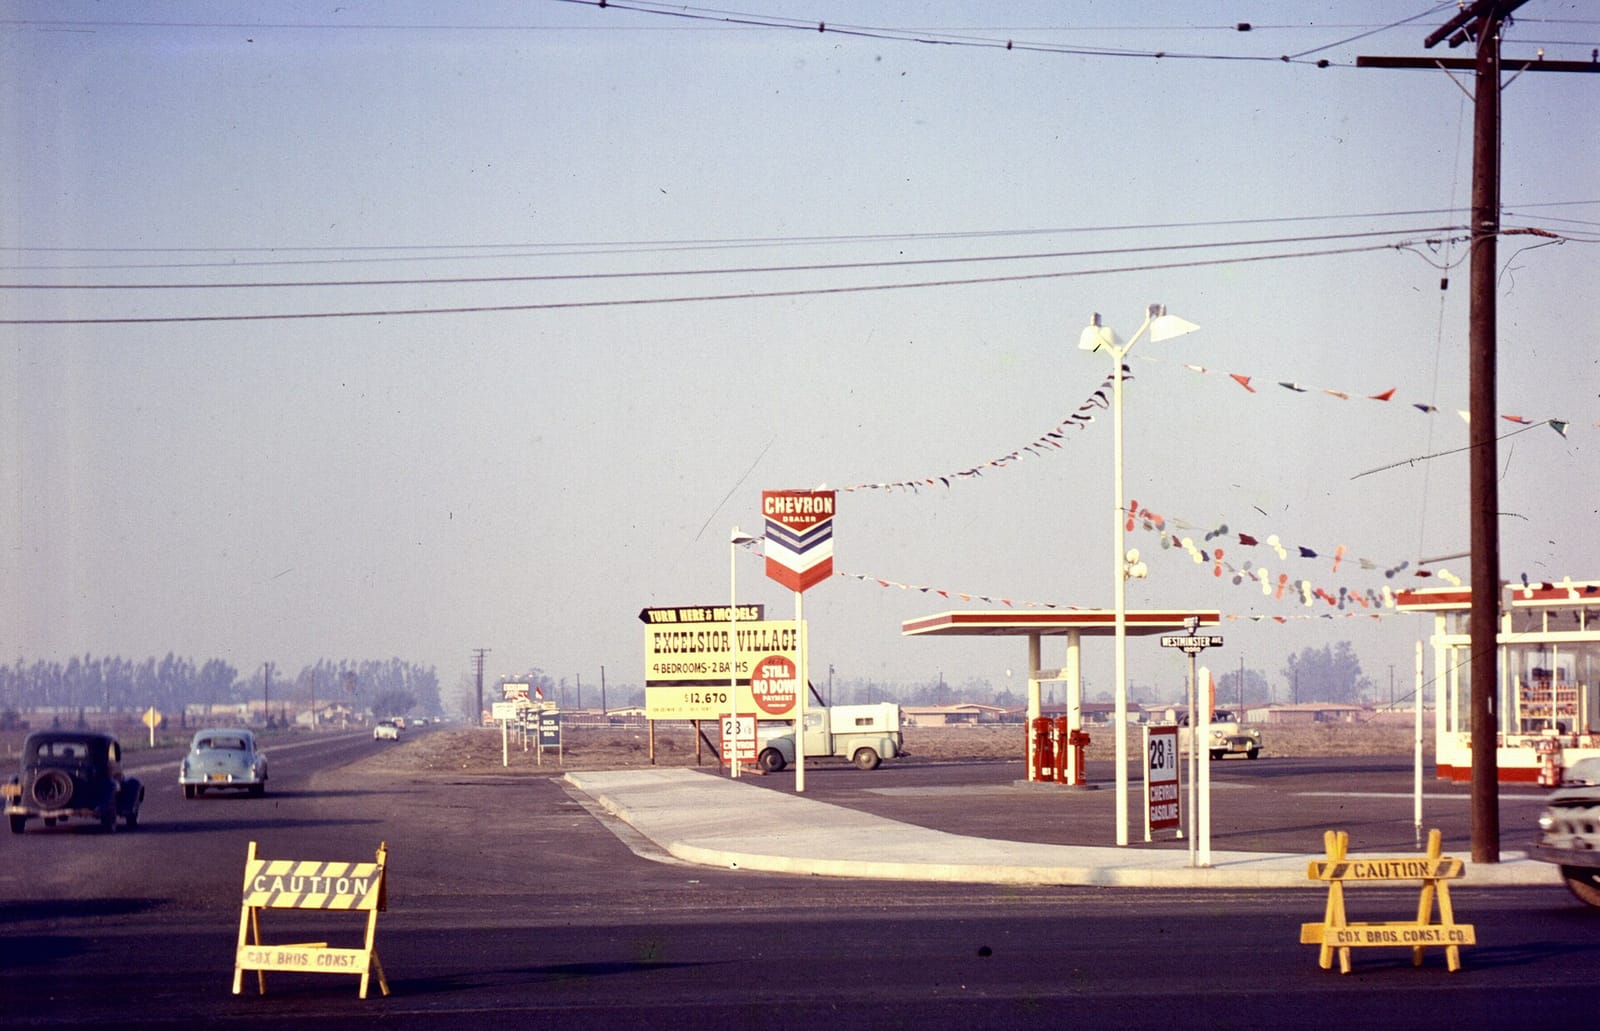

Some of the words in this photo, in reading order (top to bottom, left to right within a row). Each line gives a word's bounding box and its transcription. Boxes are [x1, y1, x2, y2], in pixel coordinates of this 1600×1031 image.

[765, 497, 832, 514] CHEVRON
[648, 610, 677, 622] TURN
[679, 609, 705, 622] HERE
[713, 607, 758, 620] MODELS
[654, 631, 730, 653] EXCELSIOR
[737, 630, 796, 652] VILLAGE
[1162, 637, 1210, 646] WESTMINSTER
[653, 664, 659, 673] 4
[719, 662, 748, 672] BAHS
[762, 665, 789, 678] STILL
[753, 680, 768, 694] NO
[770, 680, 797, 694] DOW
[1150, 740, 1164, 769] 28
[1151, 784, 1177, 801] CHEVRON
[1151, 804, 1178, 821] GASOLINE
[1354, 862, 1429, 878] CAUTION
[254, 876, 368, 895] CAUTION
[1338, 931, 1360, 942] COX
[247, 951, 271, 965] COX
